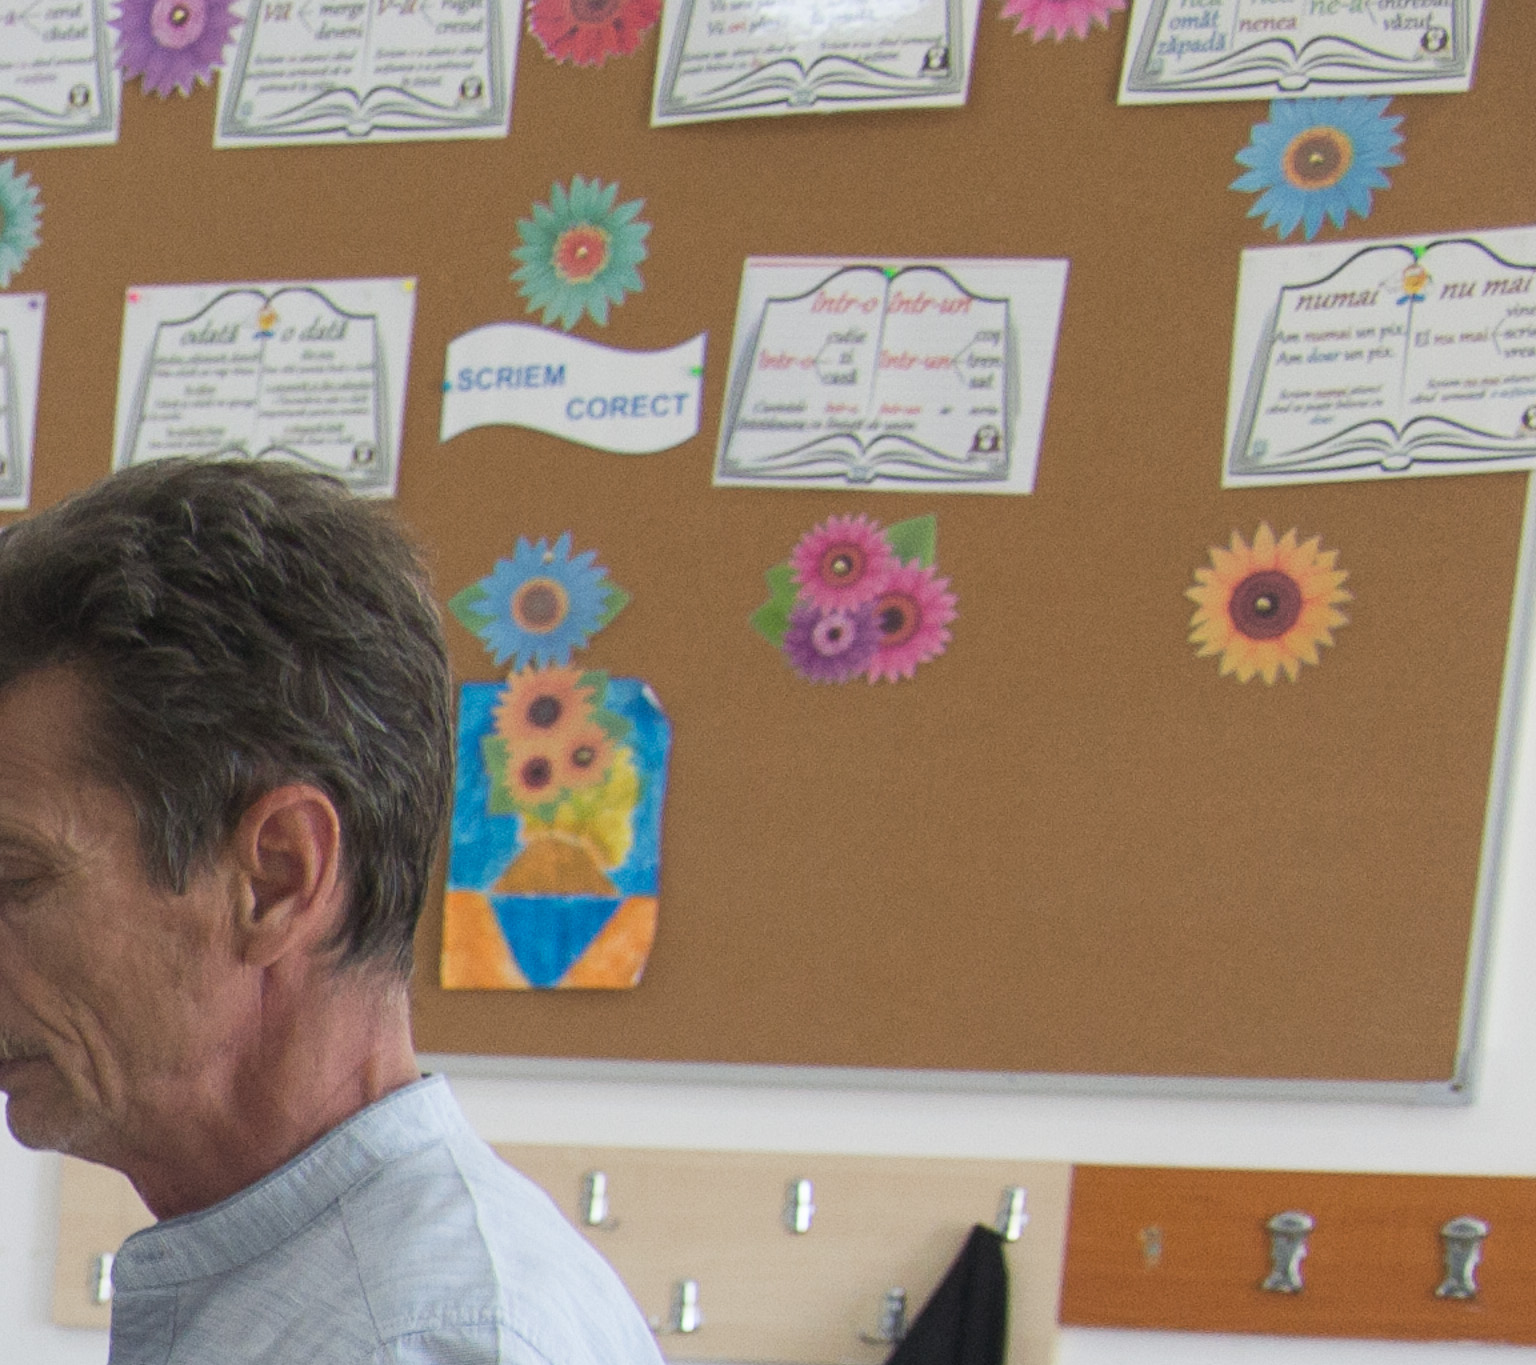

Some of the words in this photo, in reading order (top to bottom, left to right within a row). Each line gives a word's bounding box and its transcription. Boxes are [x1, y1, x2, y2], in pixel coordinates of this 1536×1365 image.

[1295, 284, 1382, 312] numai
[1440, 281, 1475, 300] nu
[1481, 274, 1534, 297] mai
[457, 363, 567, 392] SCRIEM
[564, 393, 690, 421] CORECT
